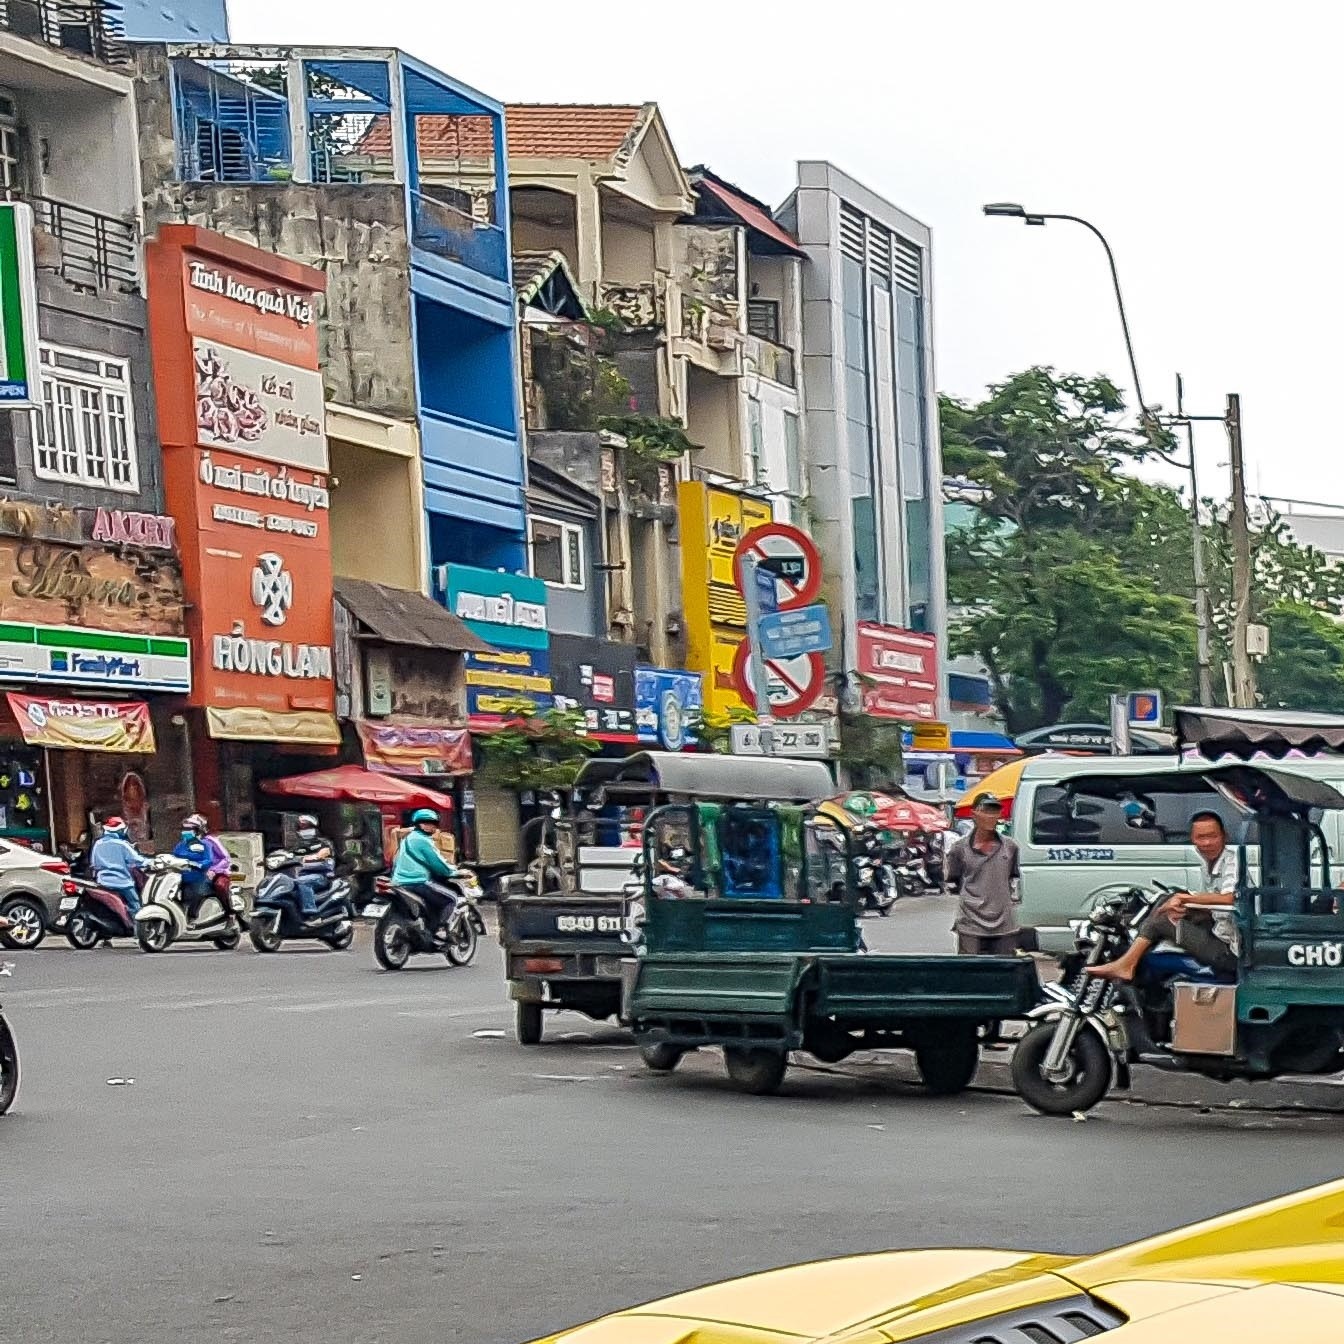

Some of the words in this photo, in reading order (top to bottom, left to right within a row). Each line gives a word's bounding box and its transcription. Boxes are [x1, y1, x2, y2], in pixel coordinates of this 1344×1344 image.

[189, 261, 224, 294] Tinh
[226, 275, 255, 303] hoa
[255, 288, 285, 314] quà
[71, 653, 141, 676] FamilyMart
